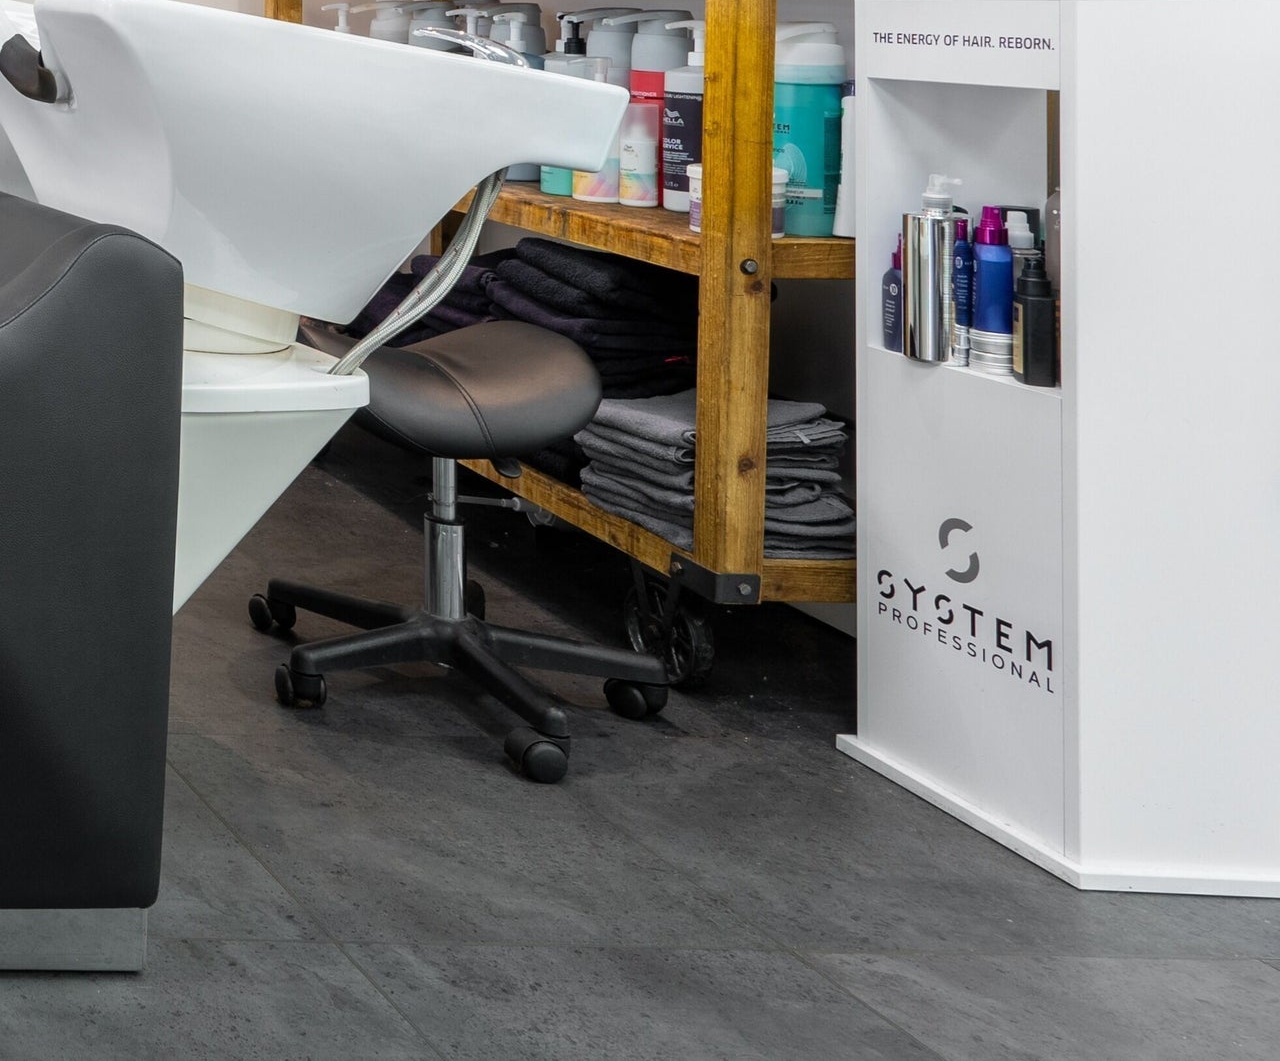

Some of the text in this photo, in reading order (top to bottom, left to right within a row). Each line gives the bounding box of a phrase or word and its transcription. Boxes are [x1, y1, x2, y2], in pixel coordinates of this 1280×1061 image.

[873, 32, 1055, 50] THE ENERGY OF HAIR. REBORN.
[877, 569, 1053, 671] SYSTEM
[878, 601, 1054, 694] PROFESSIONAL
